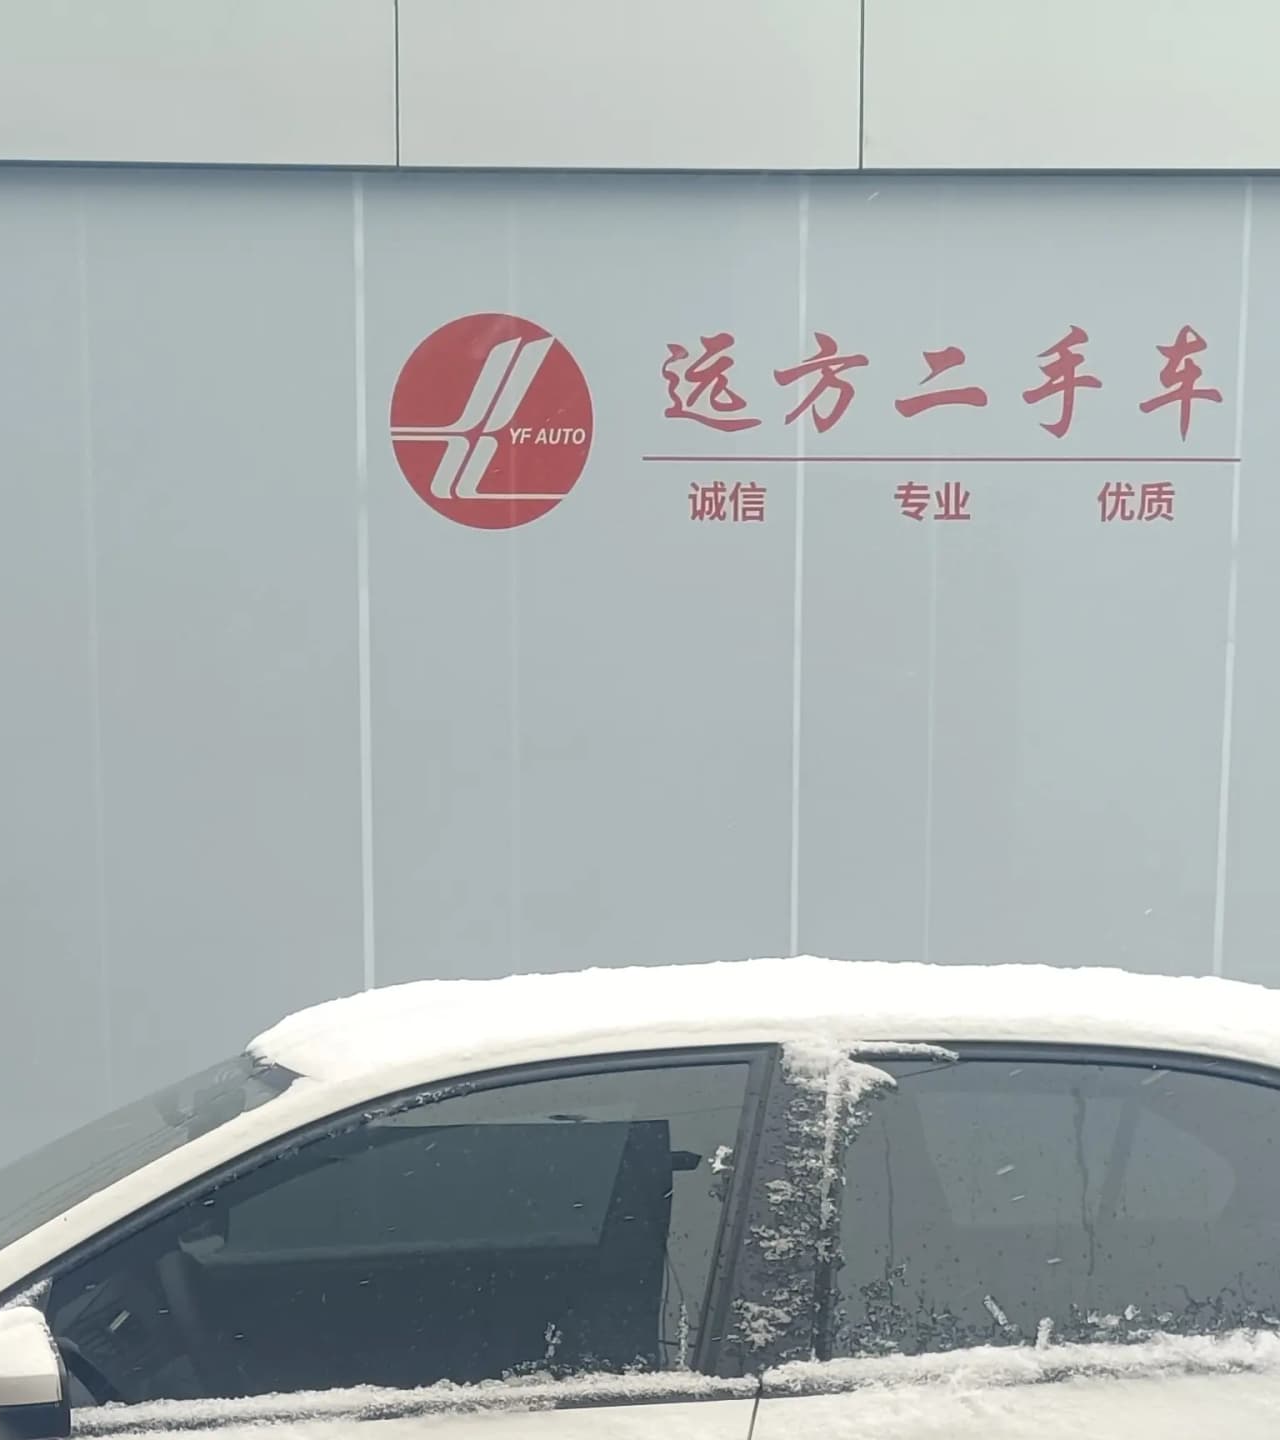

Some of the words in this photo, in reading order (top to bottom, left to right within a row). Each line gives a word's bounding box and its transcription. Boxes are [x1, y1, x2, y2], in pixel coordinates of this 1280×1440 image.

[663, 325, 1223, 441] 远方二手车
[509, 427, 533, 445] YF
[534, 427, 586, 445] AUTO
[688, 482, 767, 522] 诚信
[894, 482, 971, 522] 专业
[1097, 482, 1175, 522] 优质
